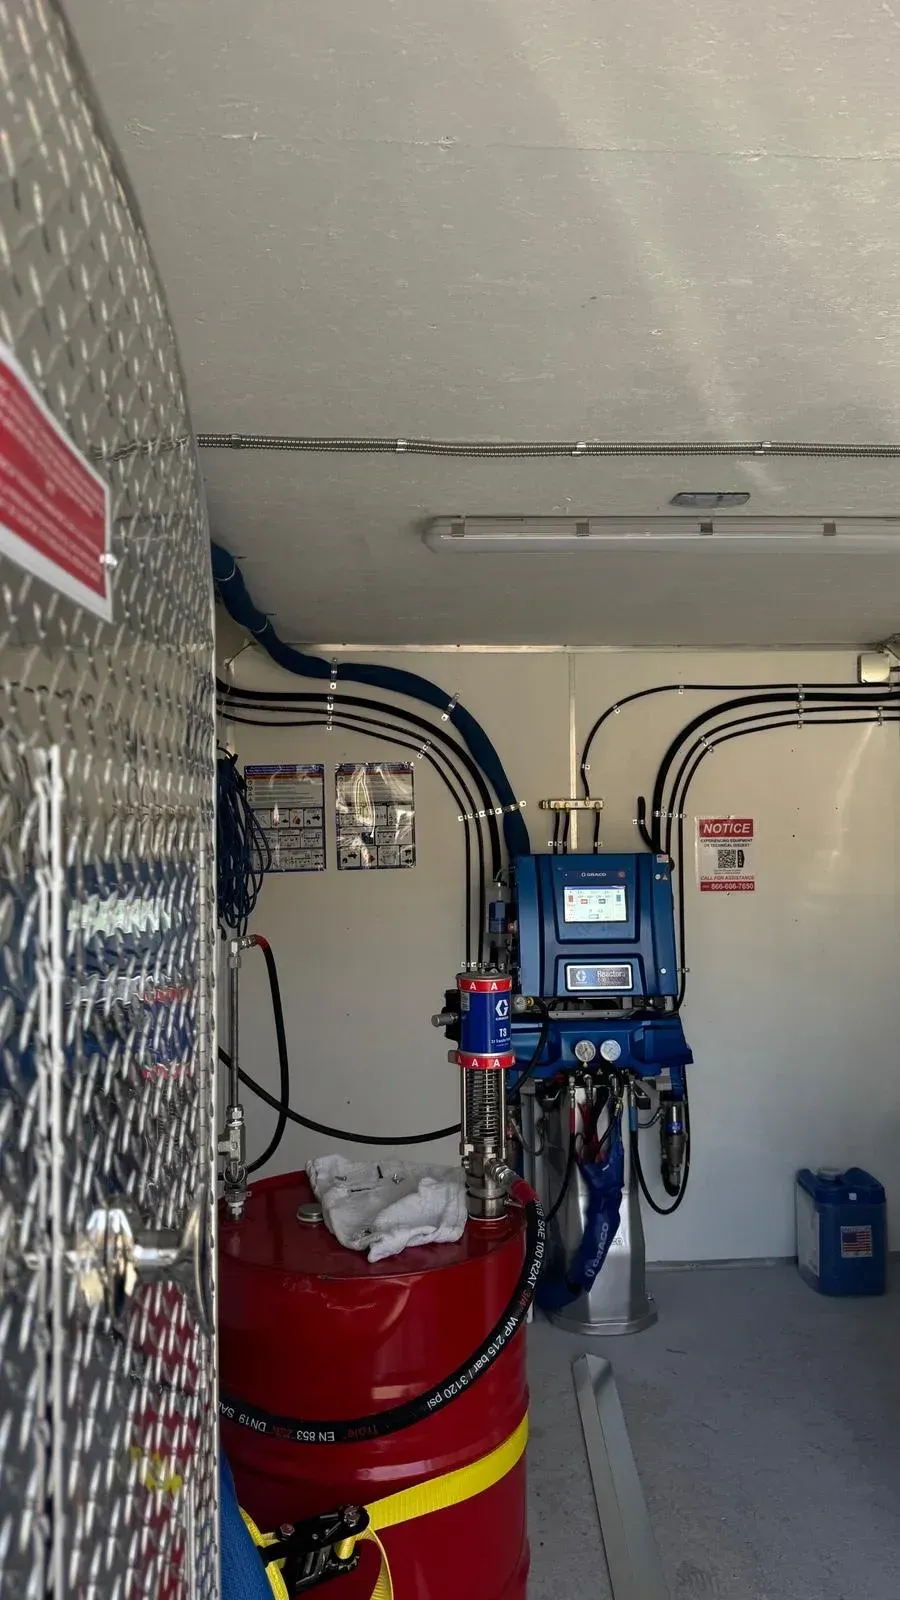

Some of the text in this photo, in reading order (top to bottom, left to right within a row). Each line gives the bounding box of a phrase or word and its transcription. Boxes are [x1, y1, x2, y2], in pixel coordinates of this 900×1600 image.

[703, 823, 750, 833] NOTICE
[469, 982, 498, 991] A A
[471, 1058, 479, 1067] A
[493, 1058, 501, 1067] A
[536, 1219, 546, 1240] SAE
[533, 1241, 545, 1258] 100
[593, 1222, 609, 1267] GRACO
[526, 1259, 543, 1290] R2AT
[504, 1316, 519, 1337] WP
[487, 1334, 505, 1357] 215
[473, 1354, 490, 1373] bar
[443, 1375, 469, 1399] 3120
[426, 1391, 443, 1410] psi
[238, 1412, 267, 1433] DN19
[296, 1429, 316, 1442] 853
[318, 1431, 336, 1443] EN
